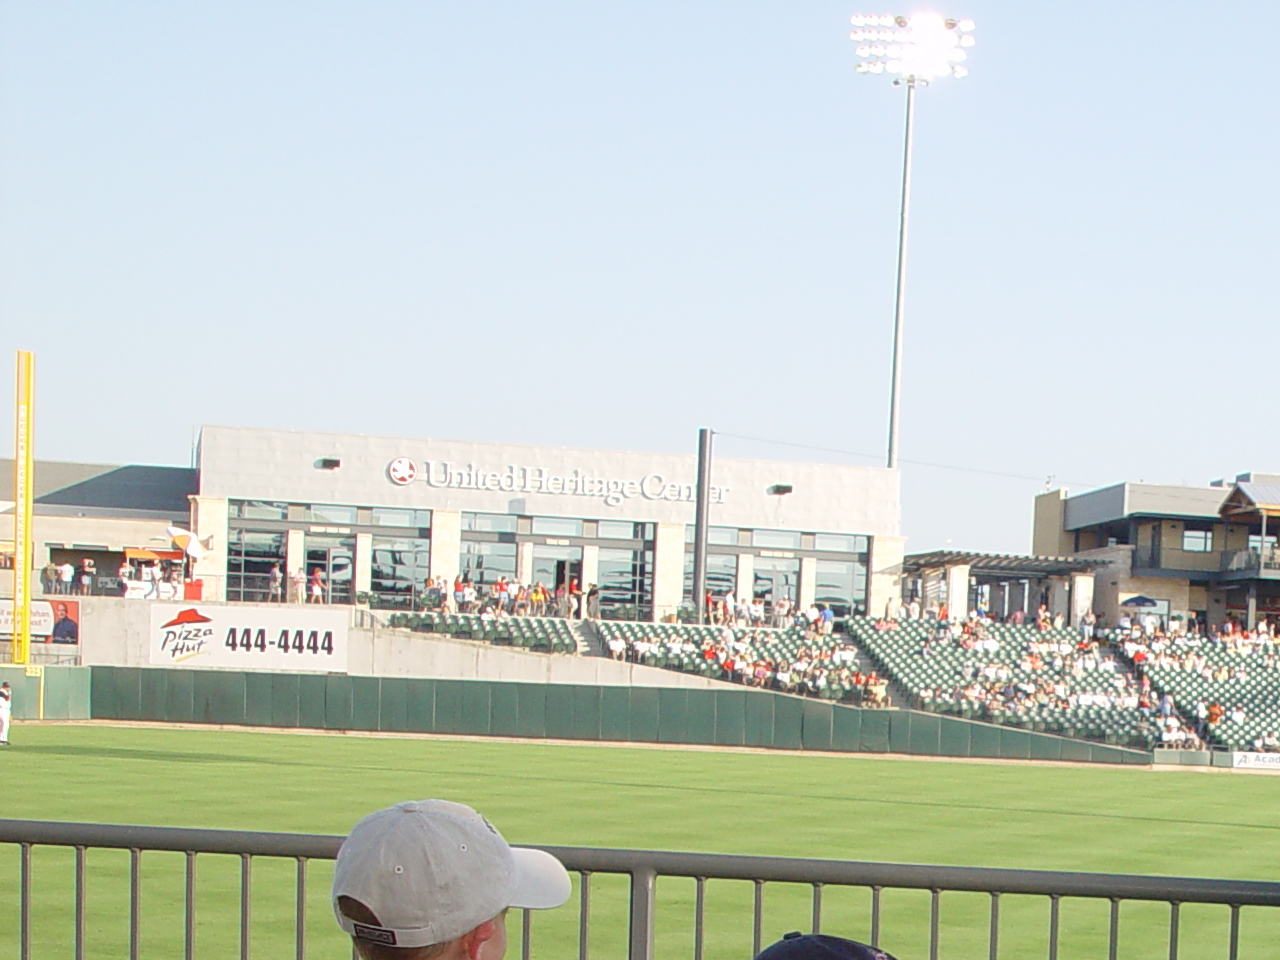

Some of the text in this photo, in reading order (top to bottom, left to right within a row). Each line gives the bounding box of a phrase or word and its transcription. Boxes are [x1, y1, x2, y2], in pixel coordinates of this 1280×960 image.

[425, 459, 732, 507] United Heritage Cener
[161, 626, 214, 651] Pizza
[171, 640, 207, 658] Hut
[225, 627, 334, 656] 444-4444
